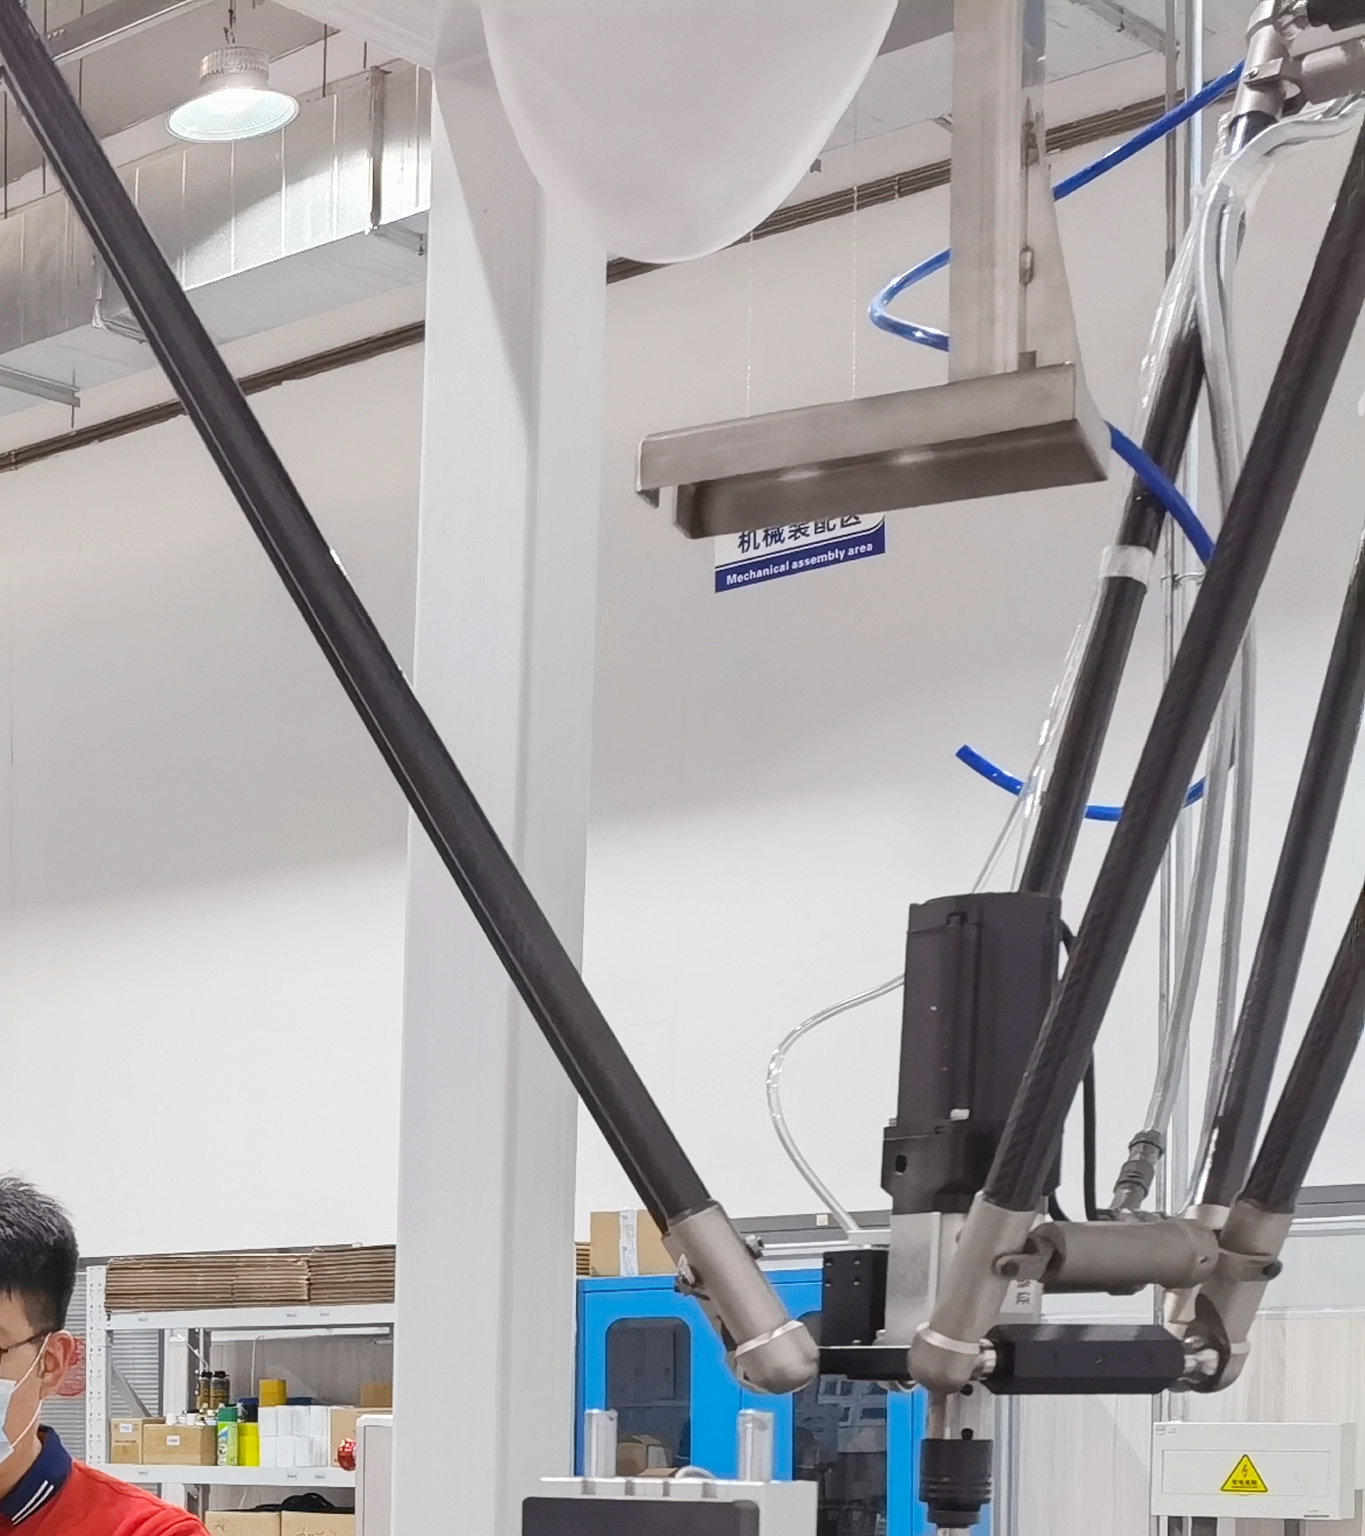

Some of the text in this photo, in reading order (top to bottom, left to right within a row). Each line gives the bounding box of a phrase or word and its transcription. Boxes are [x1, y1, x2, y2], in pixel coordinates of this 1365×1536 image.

[726, 543, 873, 586] Mechanical assembly area
